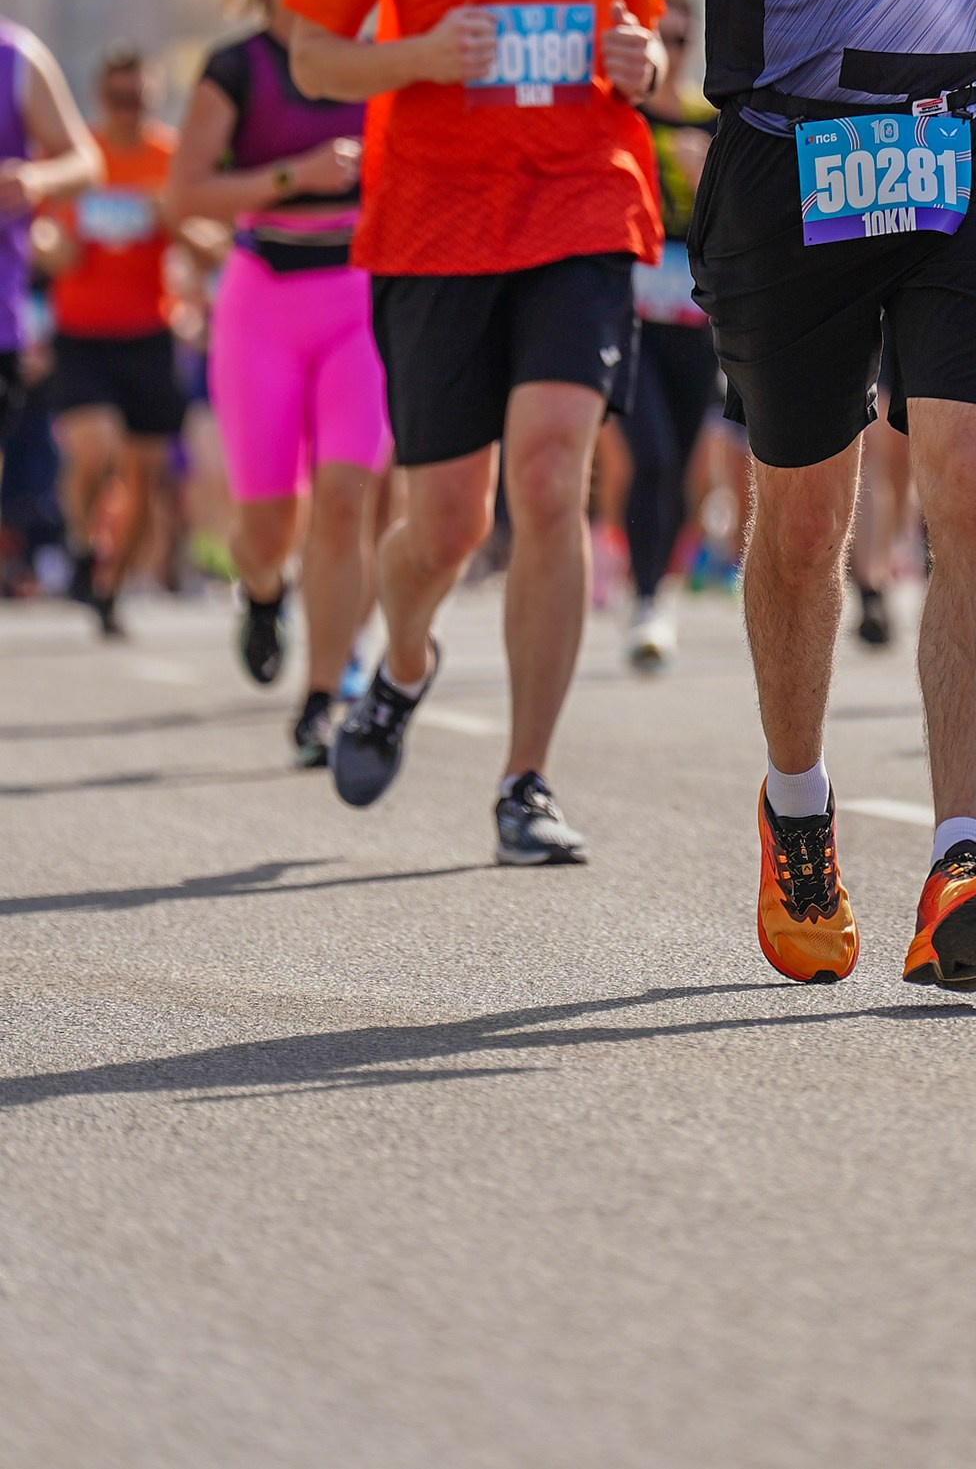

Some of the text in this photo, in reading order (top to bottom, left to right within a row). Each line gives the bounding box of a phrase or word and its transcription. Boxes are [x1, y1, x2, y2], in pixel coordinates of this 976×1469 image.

[486, 32, 588, 82] 0180
[815, 133, 838, 144] ПСБ
[870, 119, 899, 144] 10
[814, 147, 957, 214] 50281
[862, 206, 917, 237] 10KM
